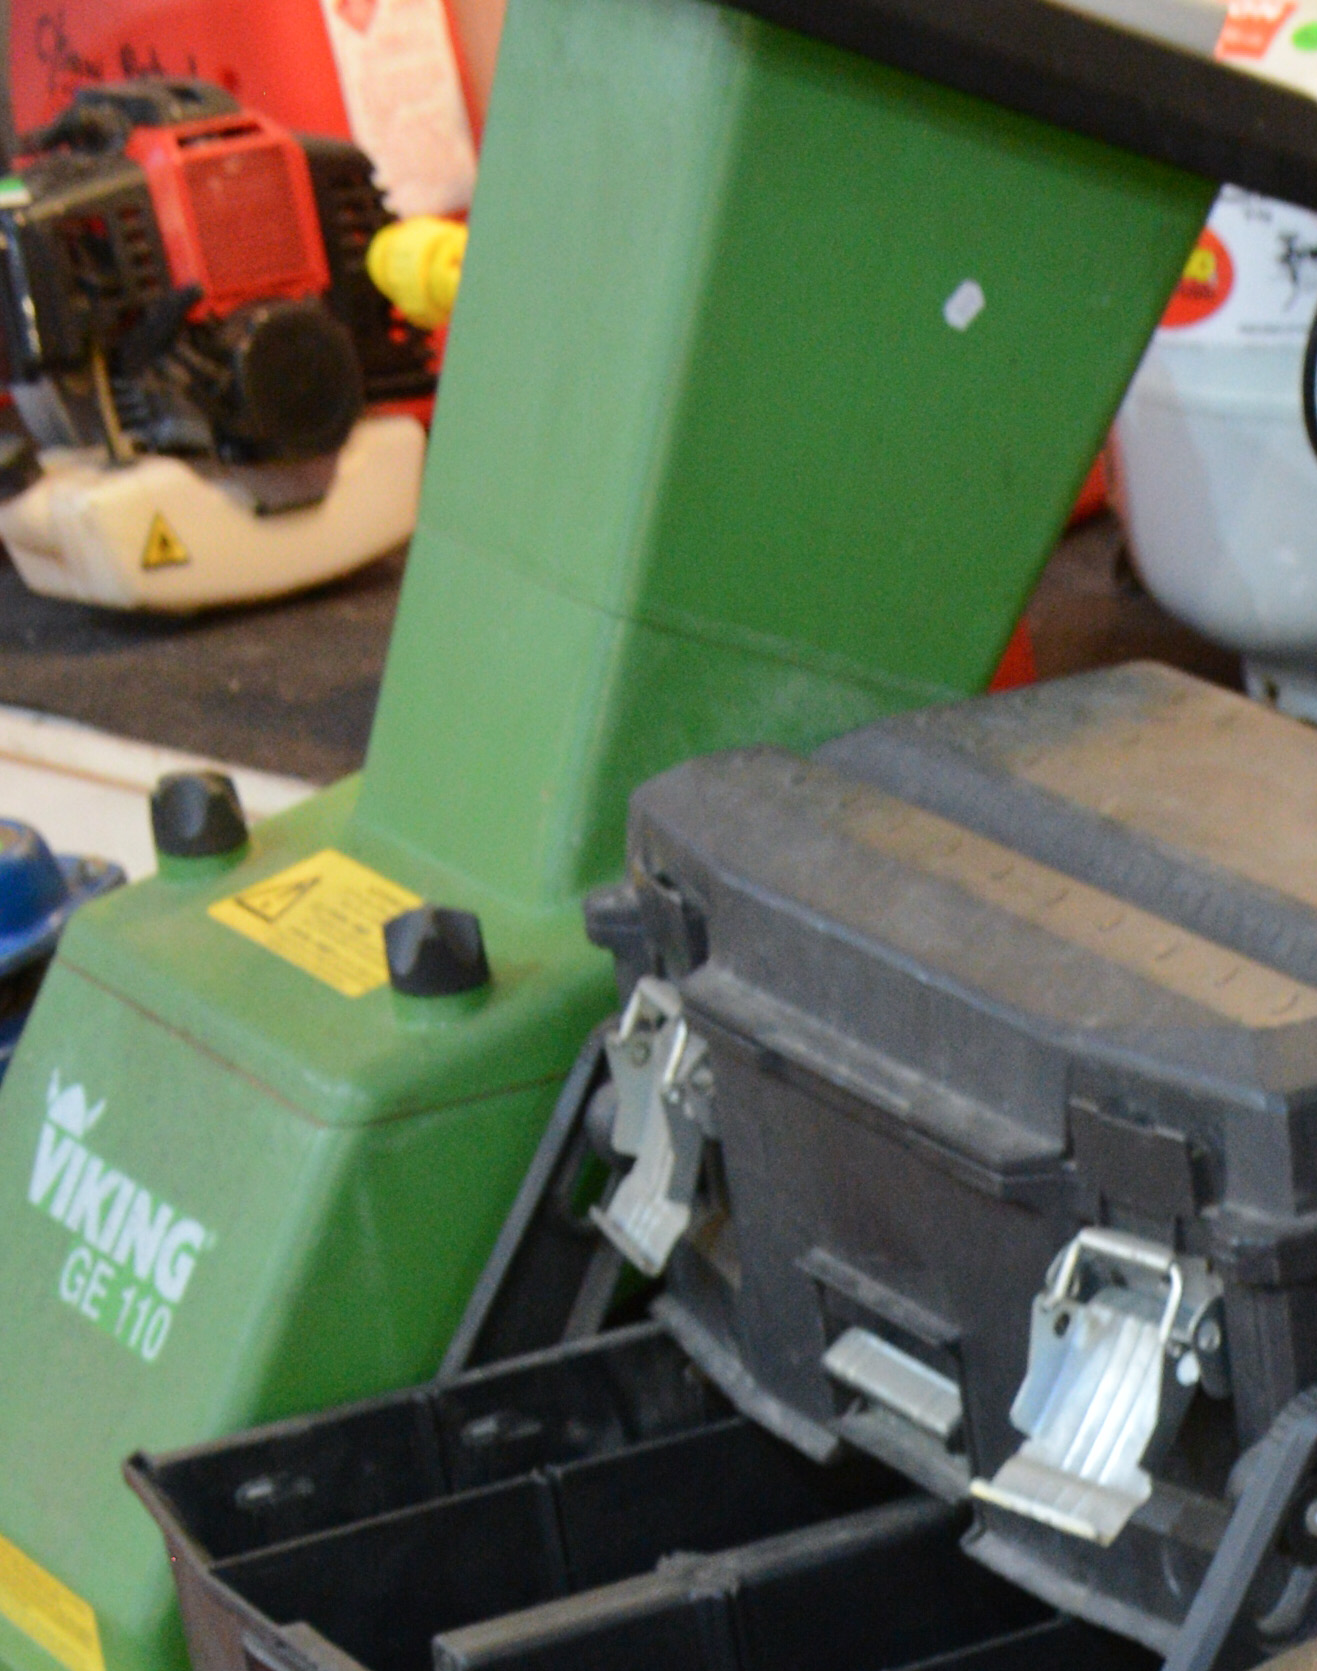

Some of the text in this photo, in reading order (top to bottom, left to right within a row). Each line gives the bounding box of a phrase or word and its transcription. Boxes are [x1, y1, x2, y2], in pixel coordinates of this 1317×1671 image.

[28, 1120, 206, 1304] VIKING
[58, 1246, 172, 1362] GE 110
